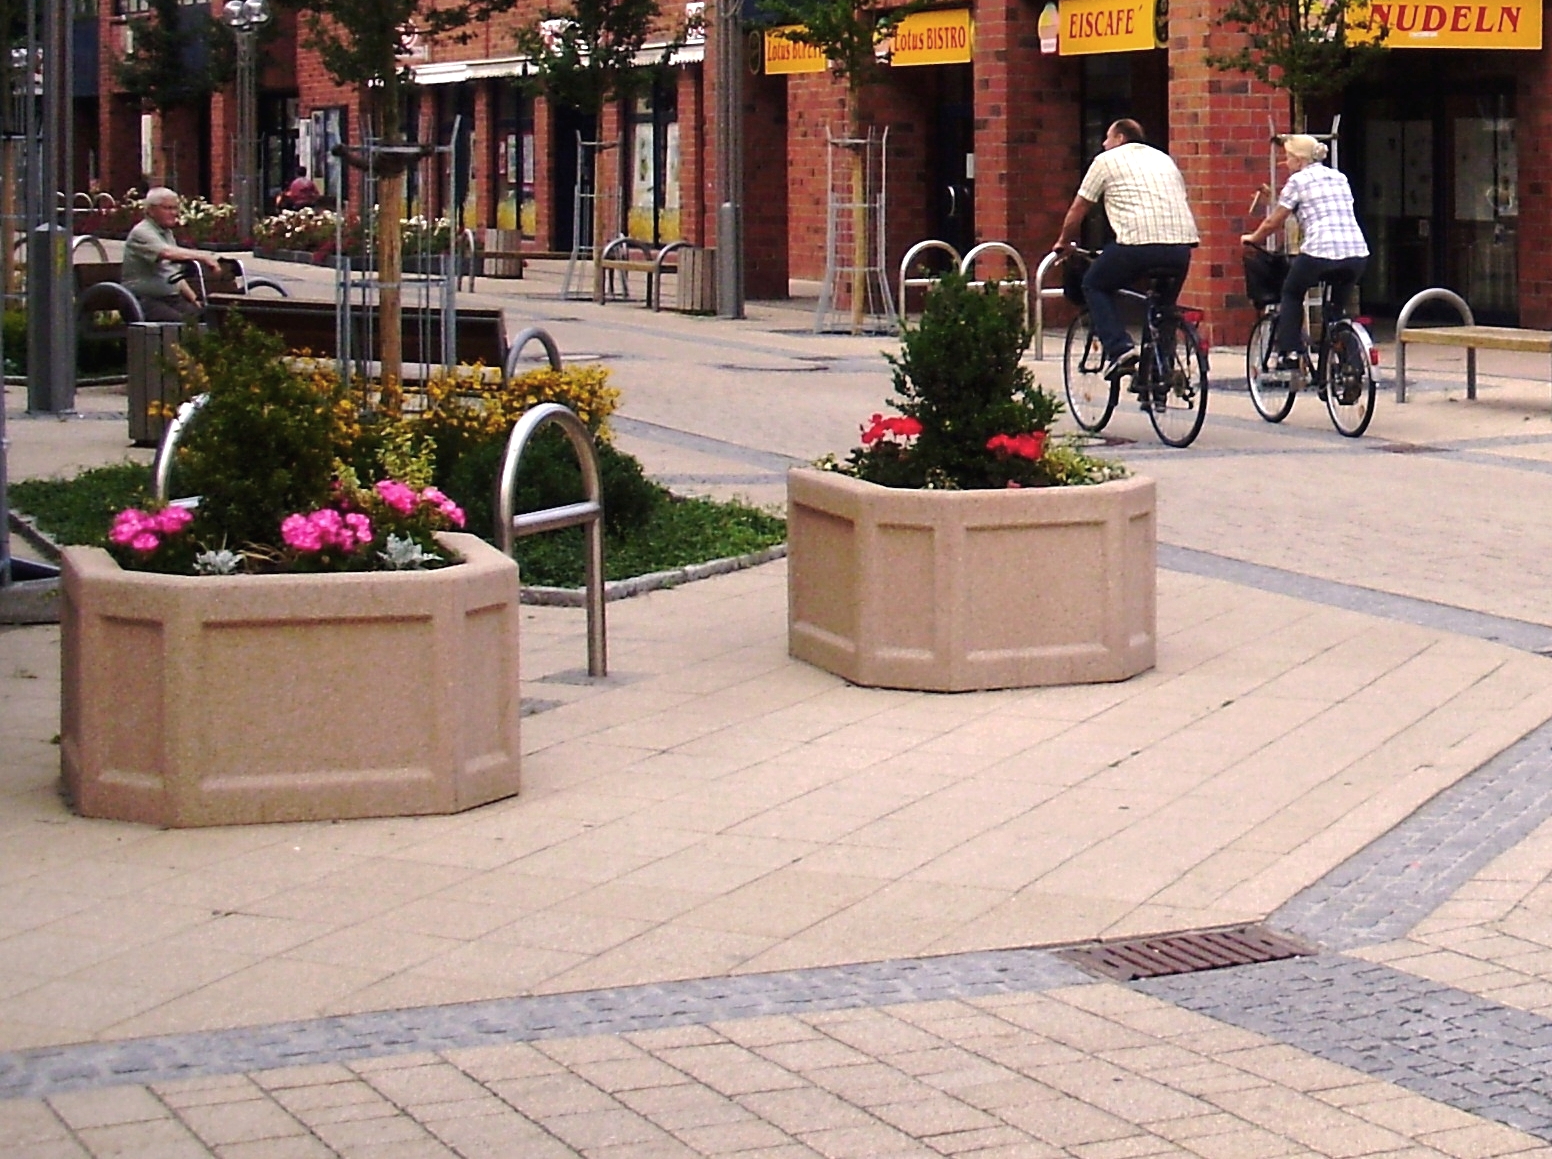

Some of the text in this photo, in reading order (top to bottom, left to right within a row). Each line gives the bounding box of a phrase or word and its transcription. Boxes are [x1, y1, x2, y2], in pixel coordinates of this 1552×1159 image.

[1367, 4, 1522, 33] NUDELN
[894, 25, 966, 52] Lotus BISTRO
